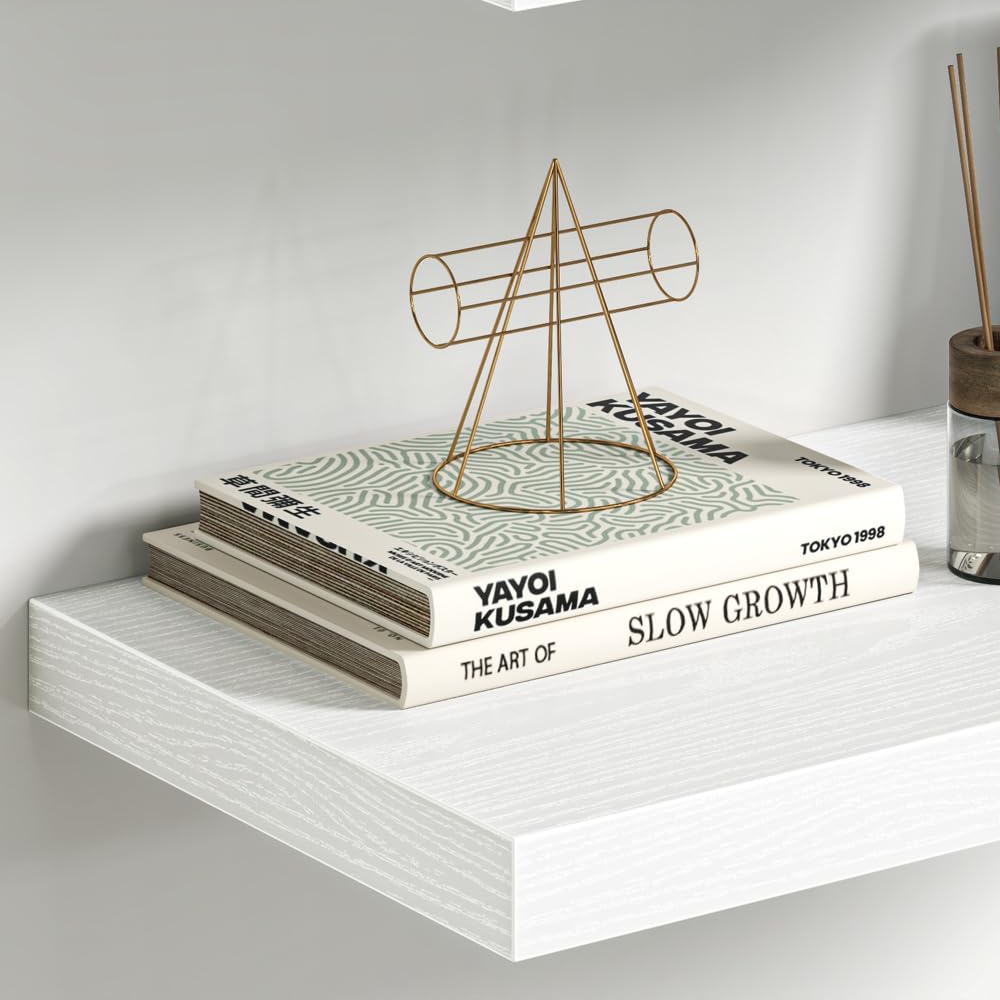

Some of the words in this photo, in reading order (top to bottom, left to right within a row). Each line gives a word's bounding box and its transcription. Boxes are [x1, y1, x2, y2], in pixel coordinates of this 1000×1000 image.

[586, 398, 749, 464] KUSAMA
[626, 391, 736, 436] YAYOI
[795, 456, 842, 476] TOKYO
[837, 474, 871, 488] 1998
[800, 533, 852, 556] TOKYO
[854, 525, 886, 544] 1998
[473, 569, 557, 607] YAYOI
[473, 586, 600, 632] KUSAMA
[628, 599, 712, 647] SLOW
[722, 568, 851, 624] GROWTH
[460, 656, 493, 681] THE
[497, 648, 529, 673] ART
[534, 641, 557, 664] OF
